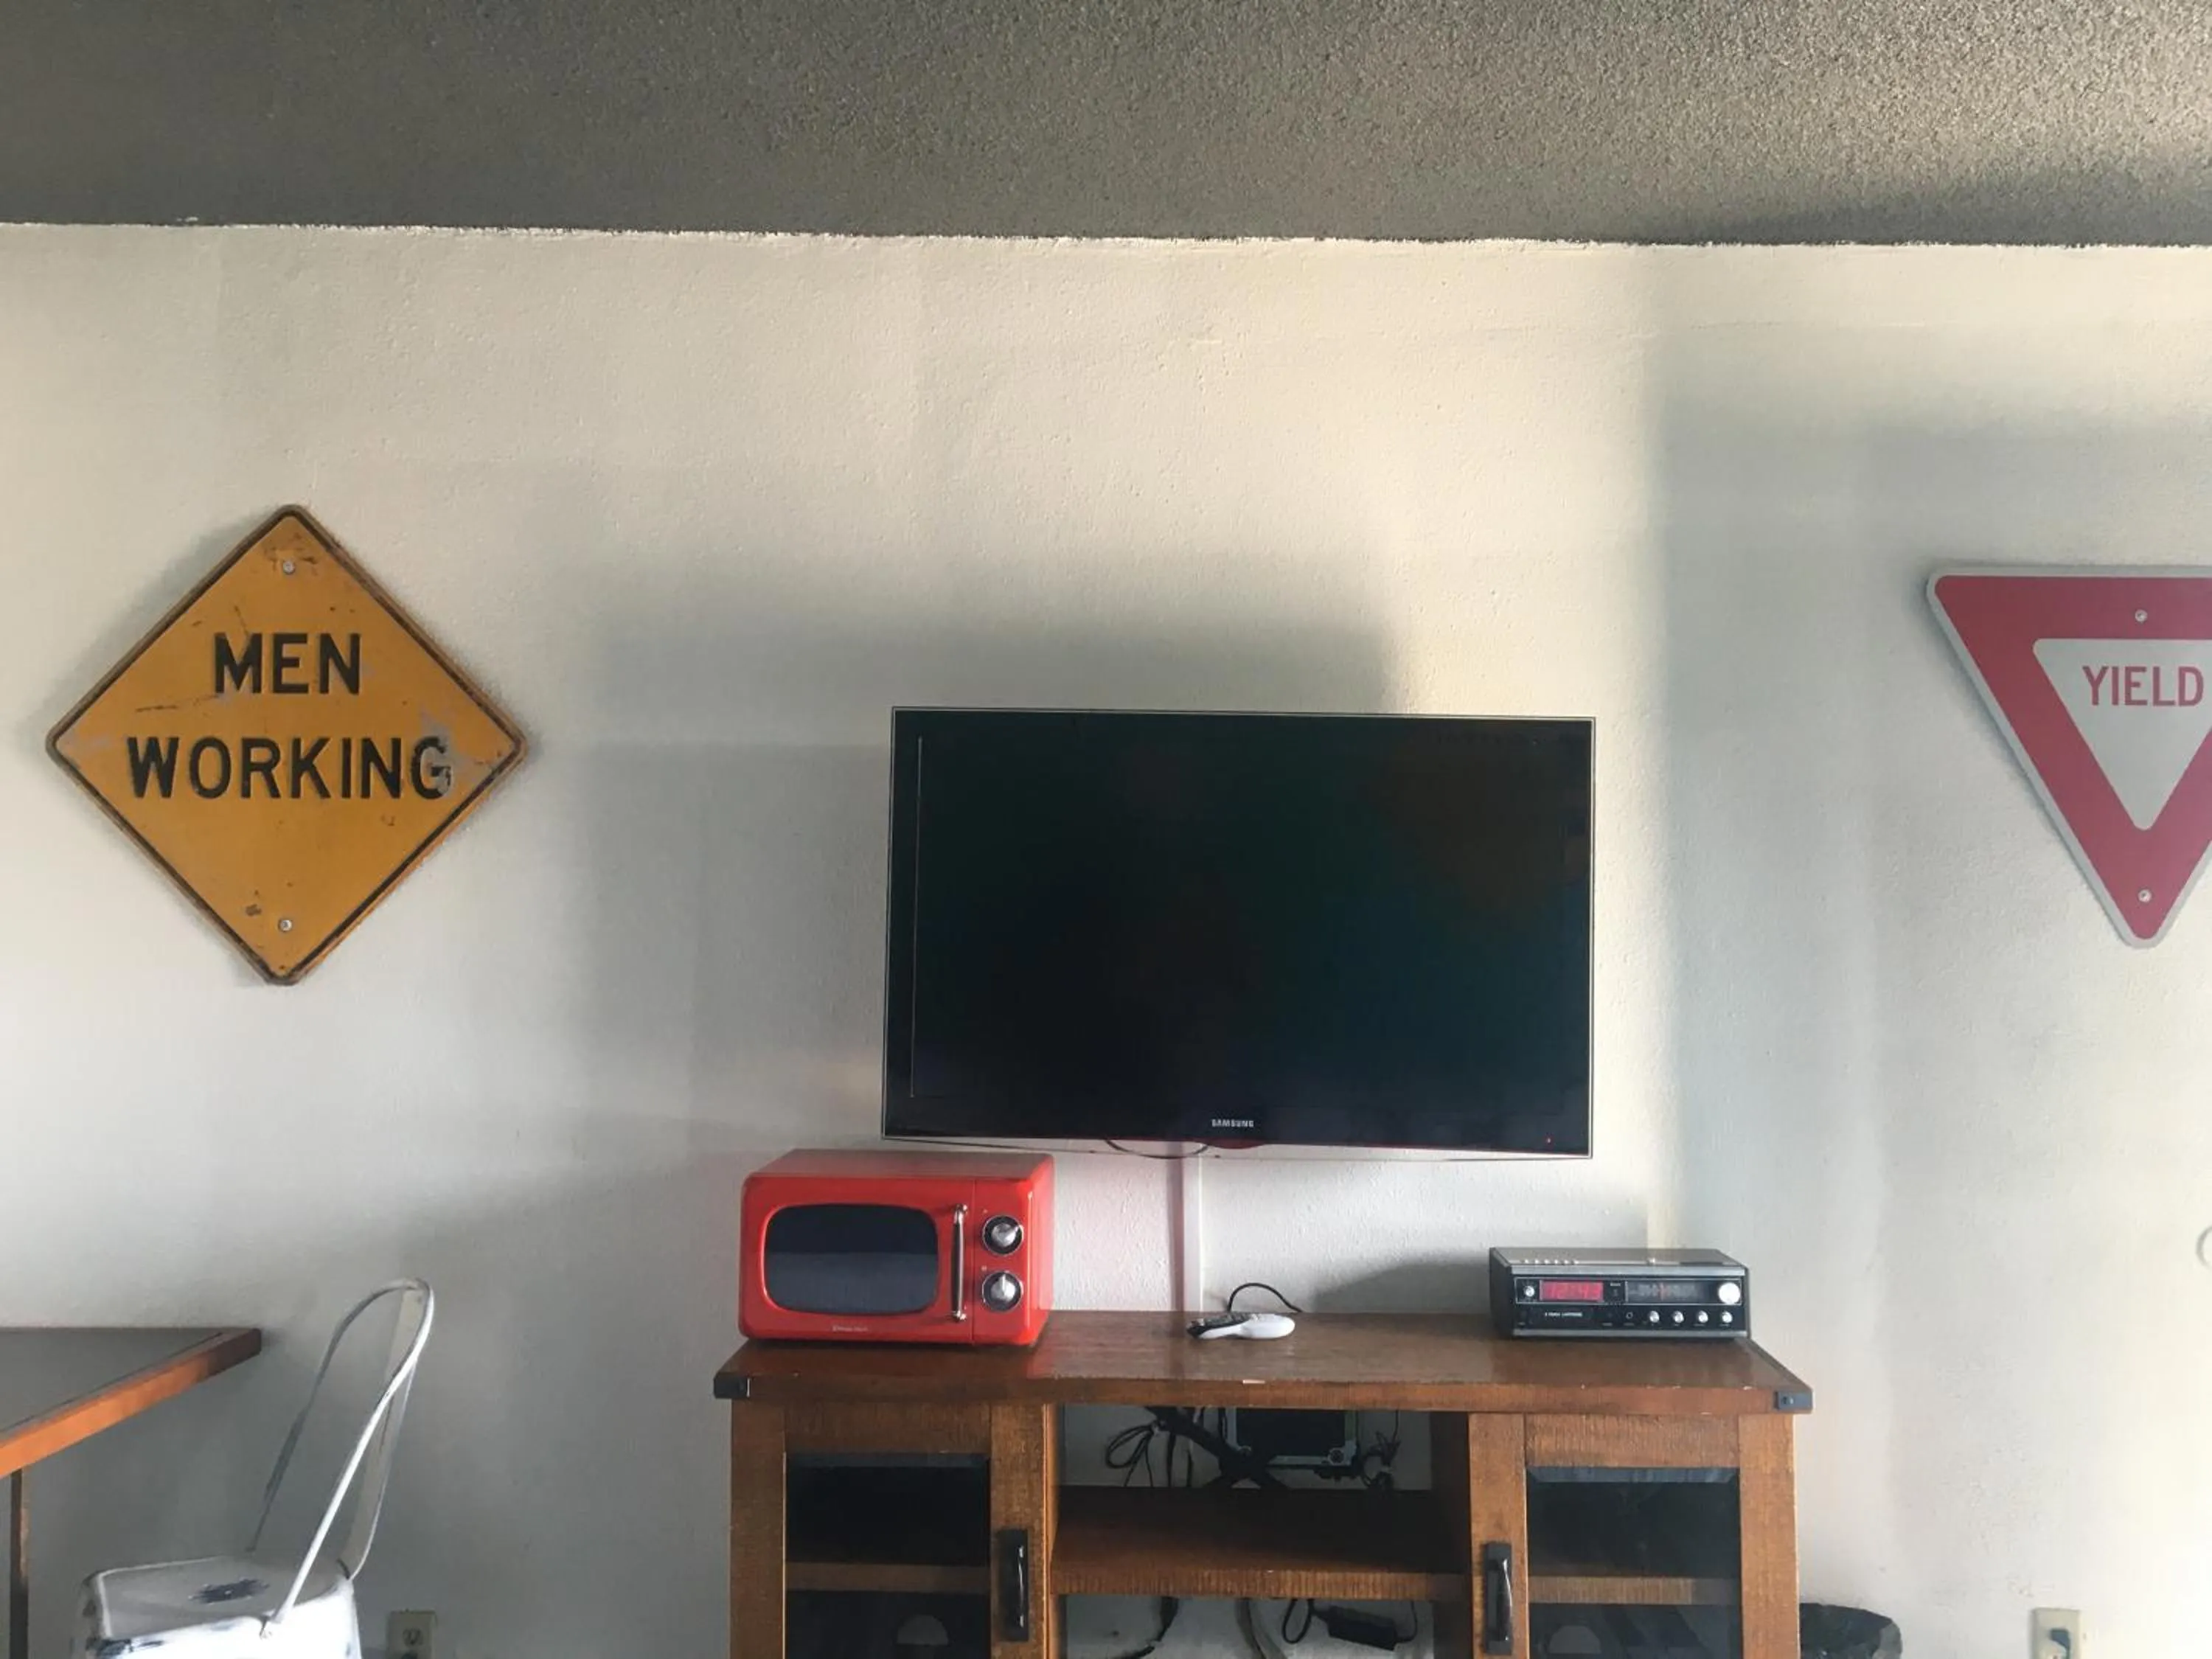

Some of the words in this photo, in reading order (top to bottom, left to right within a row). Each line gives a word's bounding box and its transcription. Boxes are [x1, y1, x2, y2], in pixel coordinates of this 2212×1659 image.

[214, 633, 361, 695] MEN
[2081, 666, 2204, 706] YIELD
[127, 737, 451, 799] WORKING
[1211, 1119, 1254, 1127] SAMSUNG
